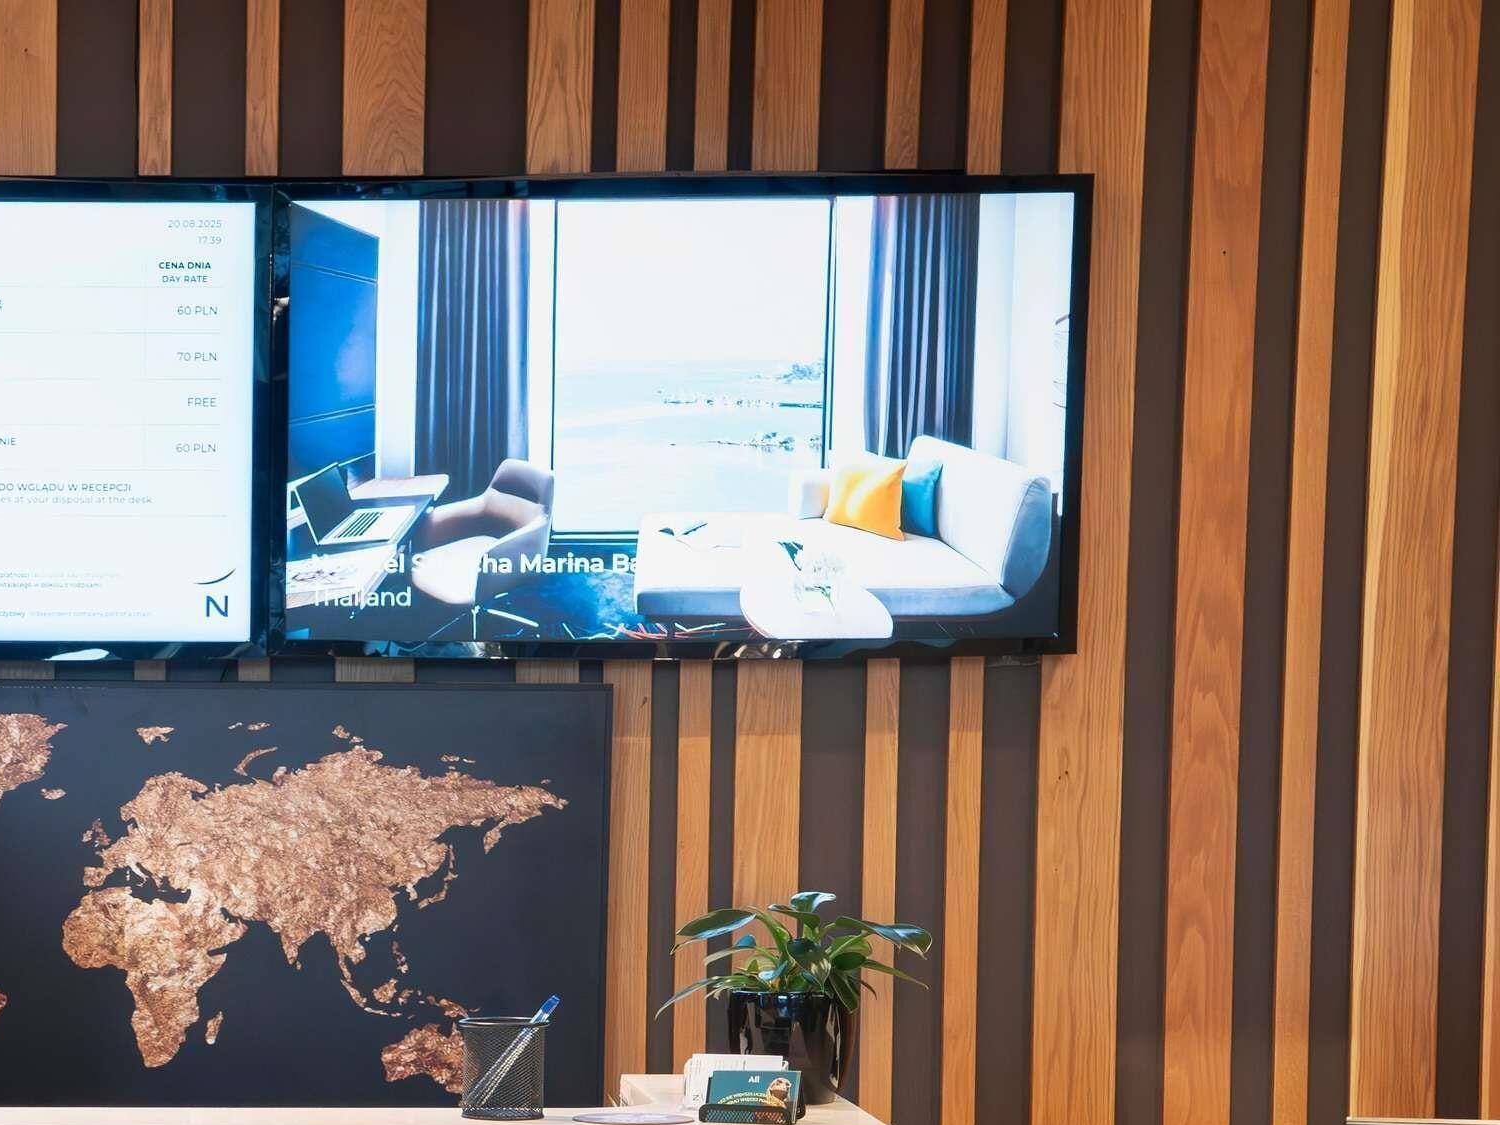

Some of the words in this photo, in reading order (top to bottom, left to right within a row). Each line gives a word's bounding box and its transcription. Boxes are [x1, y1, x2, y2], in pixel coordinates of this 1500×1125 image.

[158, 262, 185, 270] CENA
[187, 262, 212, 270] DNIA
[162, 275, 181, 284] DAY
[184, 275, 209, 284] RATE
[177, 305, 192, 316] 60
[194, 306, 218, 316] PLN
[176, 352, 192, 362] 70
[194, 352, 218, 362] PLN
[186, 398, 217, 408] FREE
[176, 444, 191, 453] 60
[193, 444, 217, 454] PLN
[68, 484, 79, 492] W
[81, 484, 132, 494] RECEPCJI
[520, 552, 605, 574] Marina
[206, 595, 229, 618] N
